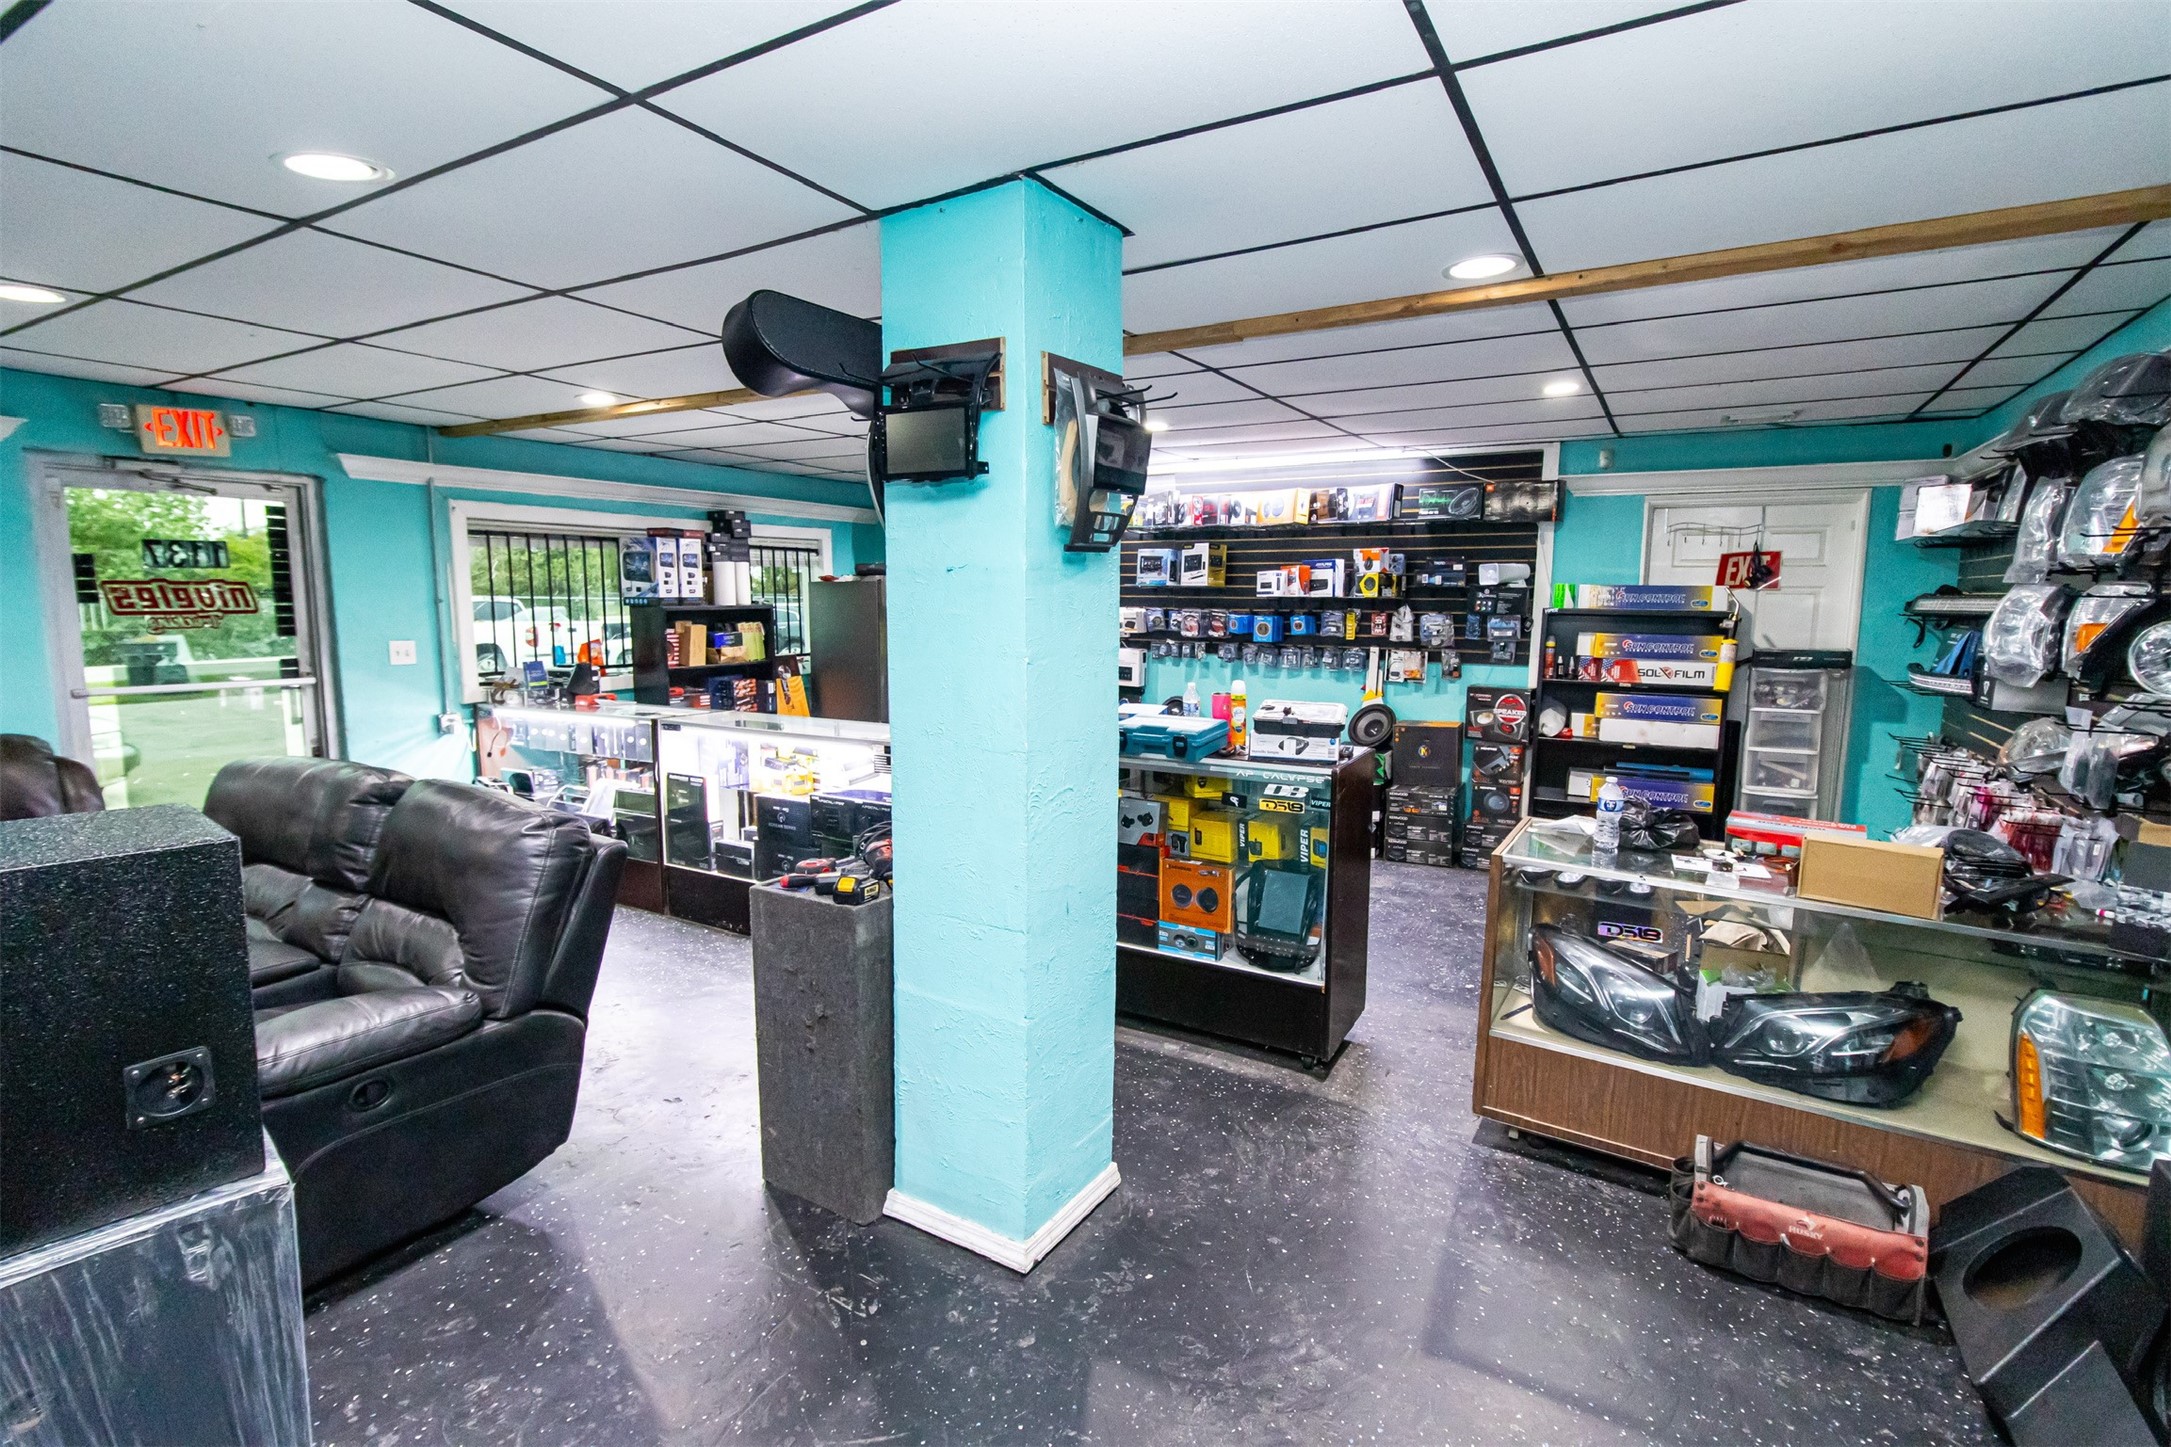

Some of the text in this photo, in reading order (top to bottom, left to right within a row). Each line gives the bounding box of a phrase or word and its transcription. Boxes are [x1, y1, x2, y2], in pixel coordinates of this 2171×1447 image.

[151, 406, 217, 450] EXIT
[1724, 554, 1771, 586] EX
[1639, 593, 1686, 602] CONTROL
[1626, 641, 1694, 652] SUN CONTROL
[1628, 703, 1696, 714] SUN CONTROL
[1640, 789, 1688, 800] CONTROL
[1311, 799, 1331, 808] VIPER
[1300, 828, 1309, 863] VIPER
[1600, 922, 1662, 941] DS18
[1788, 1225, 1824, 1240] HUSKY
